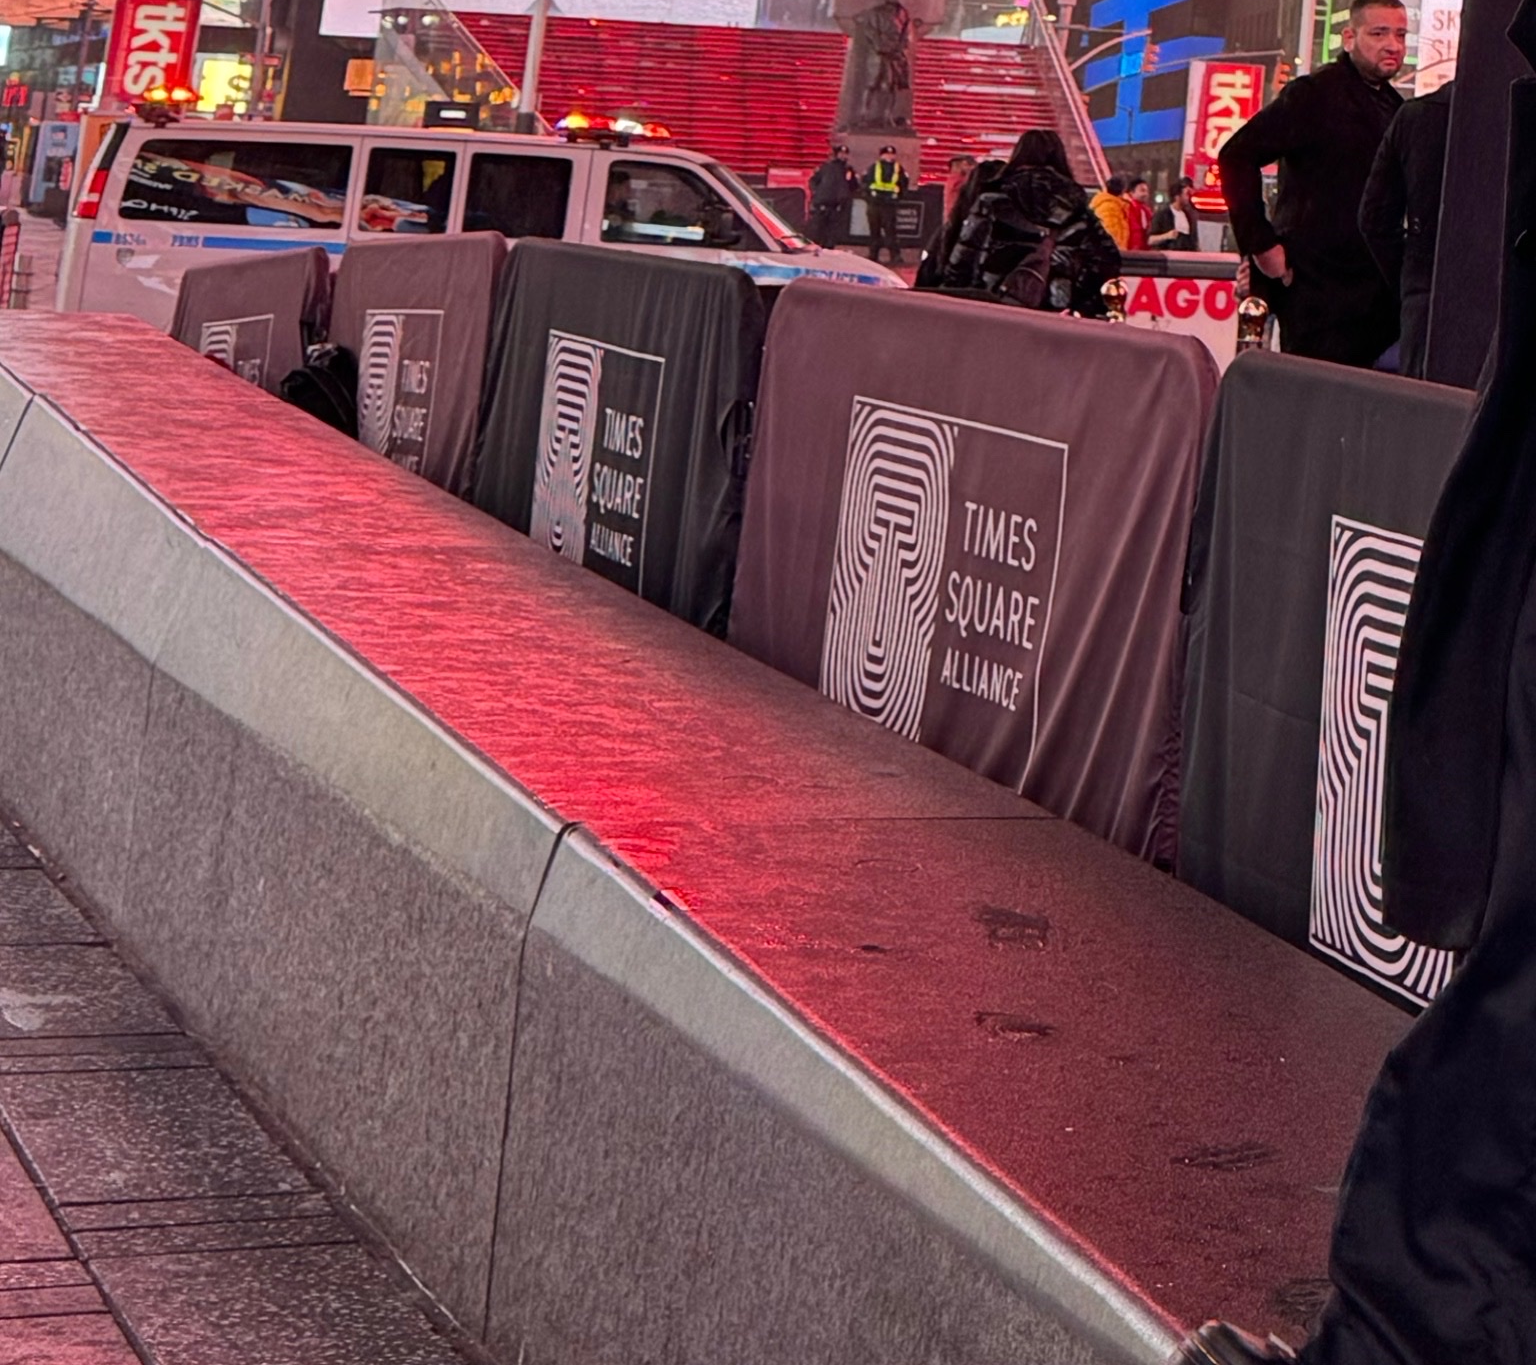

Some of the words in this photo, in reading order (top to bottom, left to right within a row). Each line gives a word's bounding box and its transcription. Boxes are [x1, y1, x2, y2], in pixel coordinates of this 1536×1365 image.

[123, 1, 187, 95] tkts
[603, 407, 645, 459] TIMES
[592, 459, 642, 519] SQUARE
[589, 523, 635, 567] ALLIANCE
[965, 501, 1037, 572] TIMES
[944, 571, 1039, 650] SQUARE
[941, 649, 1023, 712] ALLIANCE
